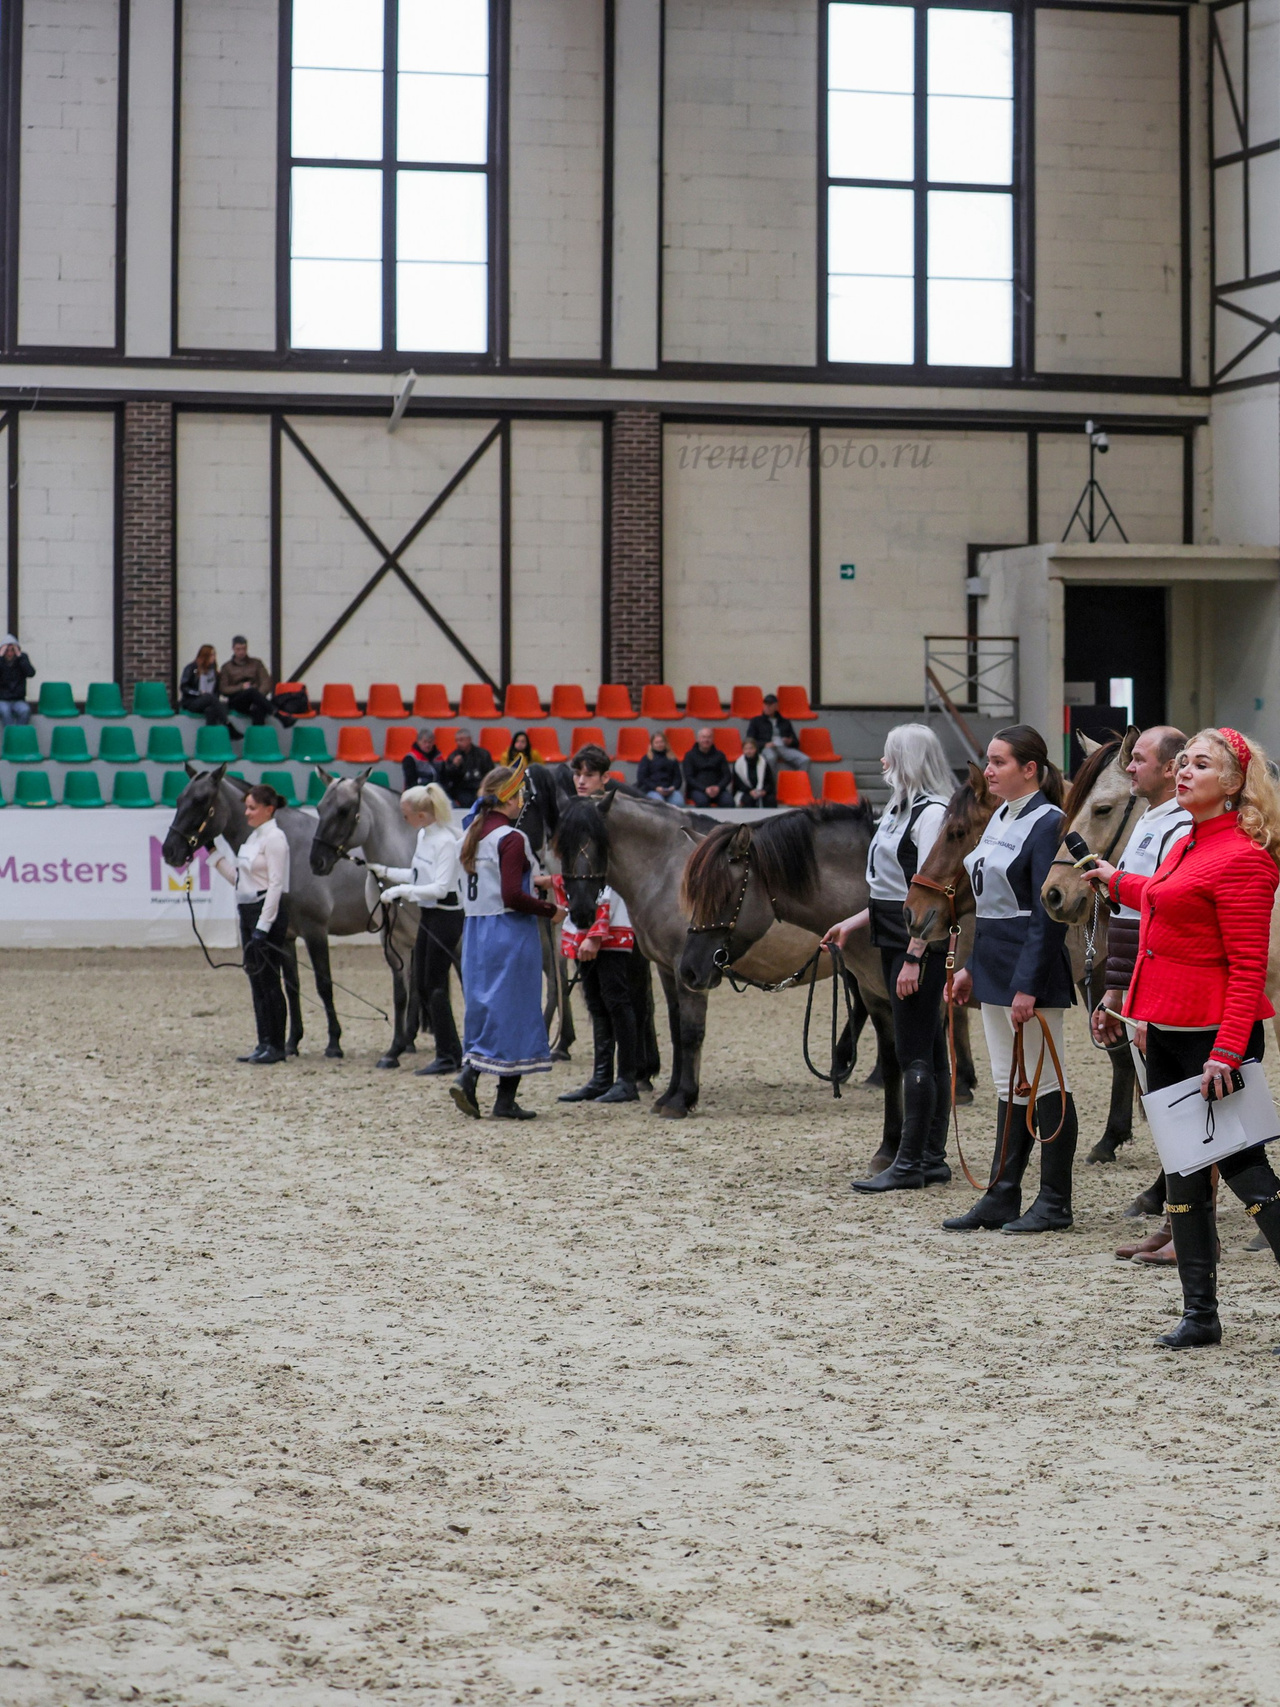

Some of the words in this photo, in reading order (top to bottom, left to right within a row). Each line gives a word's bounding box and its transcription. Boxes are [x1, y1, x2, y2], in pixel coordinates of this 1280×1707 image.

[0, 856, 128, 883] Masters
[972, 856, 985, 896] 6
[467, 873, 478, 901] 8
